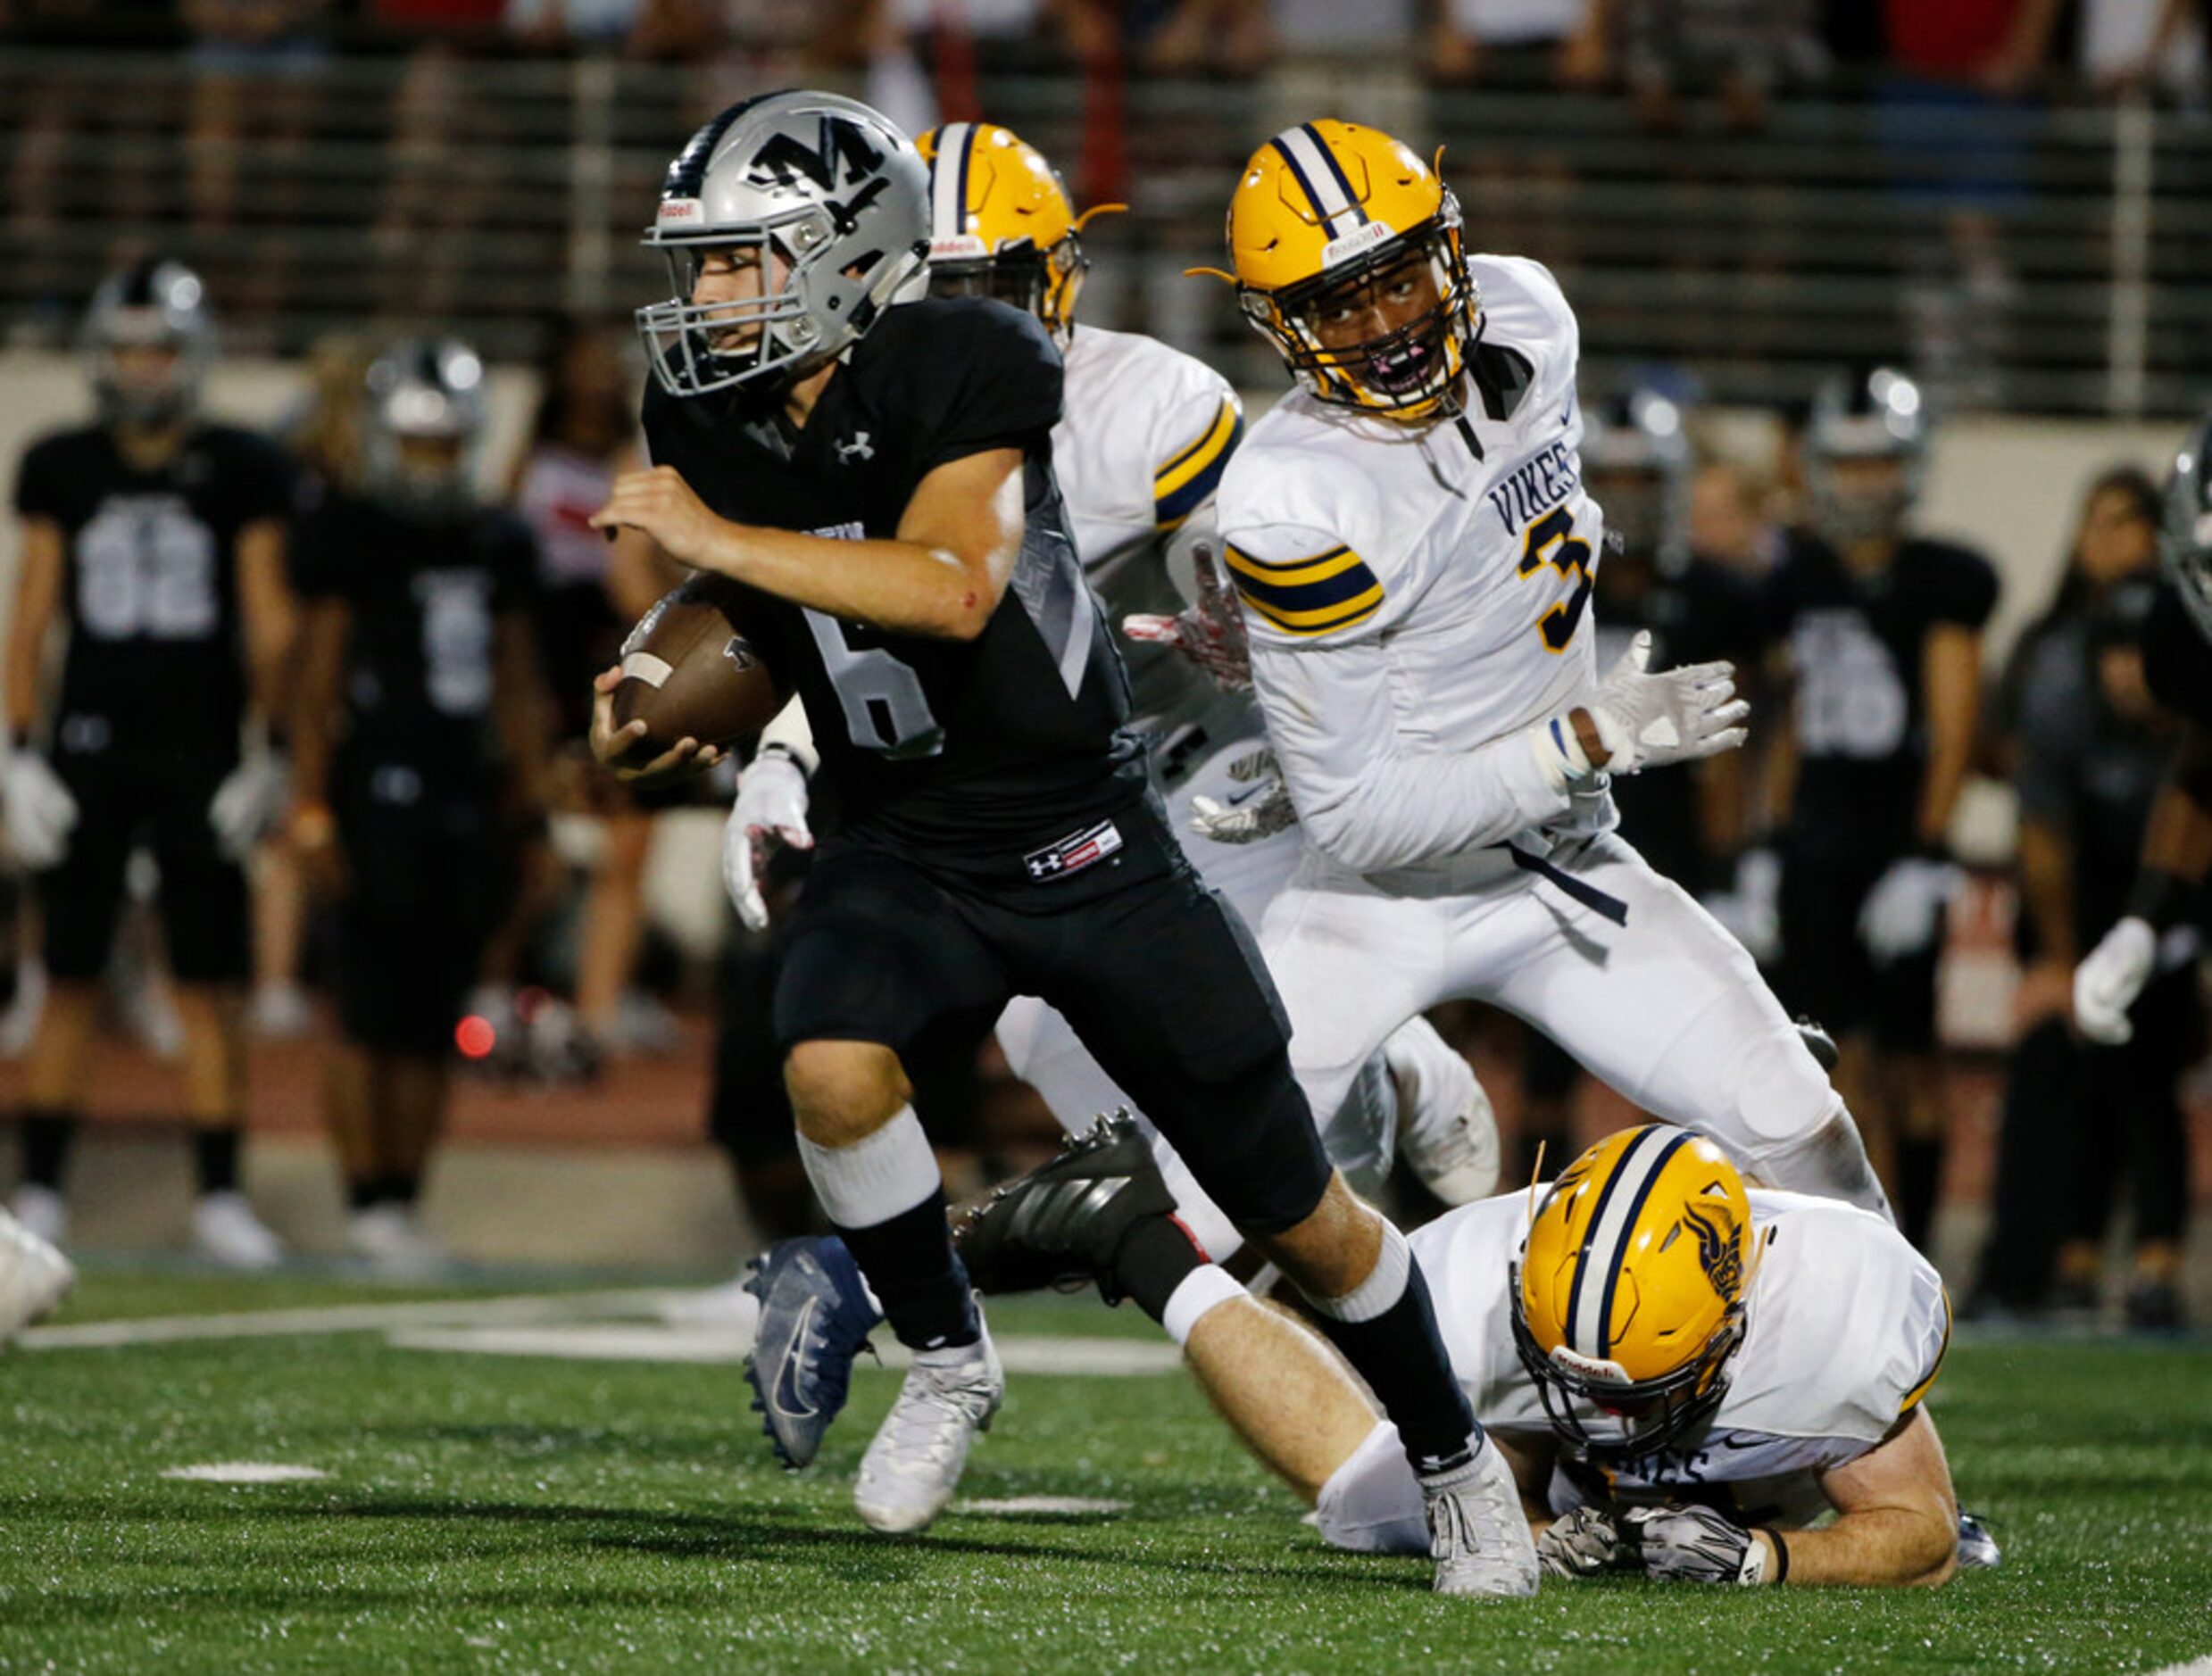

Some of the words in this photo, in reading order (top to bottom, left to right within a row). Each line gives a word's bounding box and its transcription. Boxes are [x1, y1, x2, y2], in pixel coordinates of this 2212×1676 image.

[1488, 441, 1577, 537] VIKES
[1516, 503, 1596, 655] 3
[802, 608, 946, 761] 6
